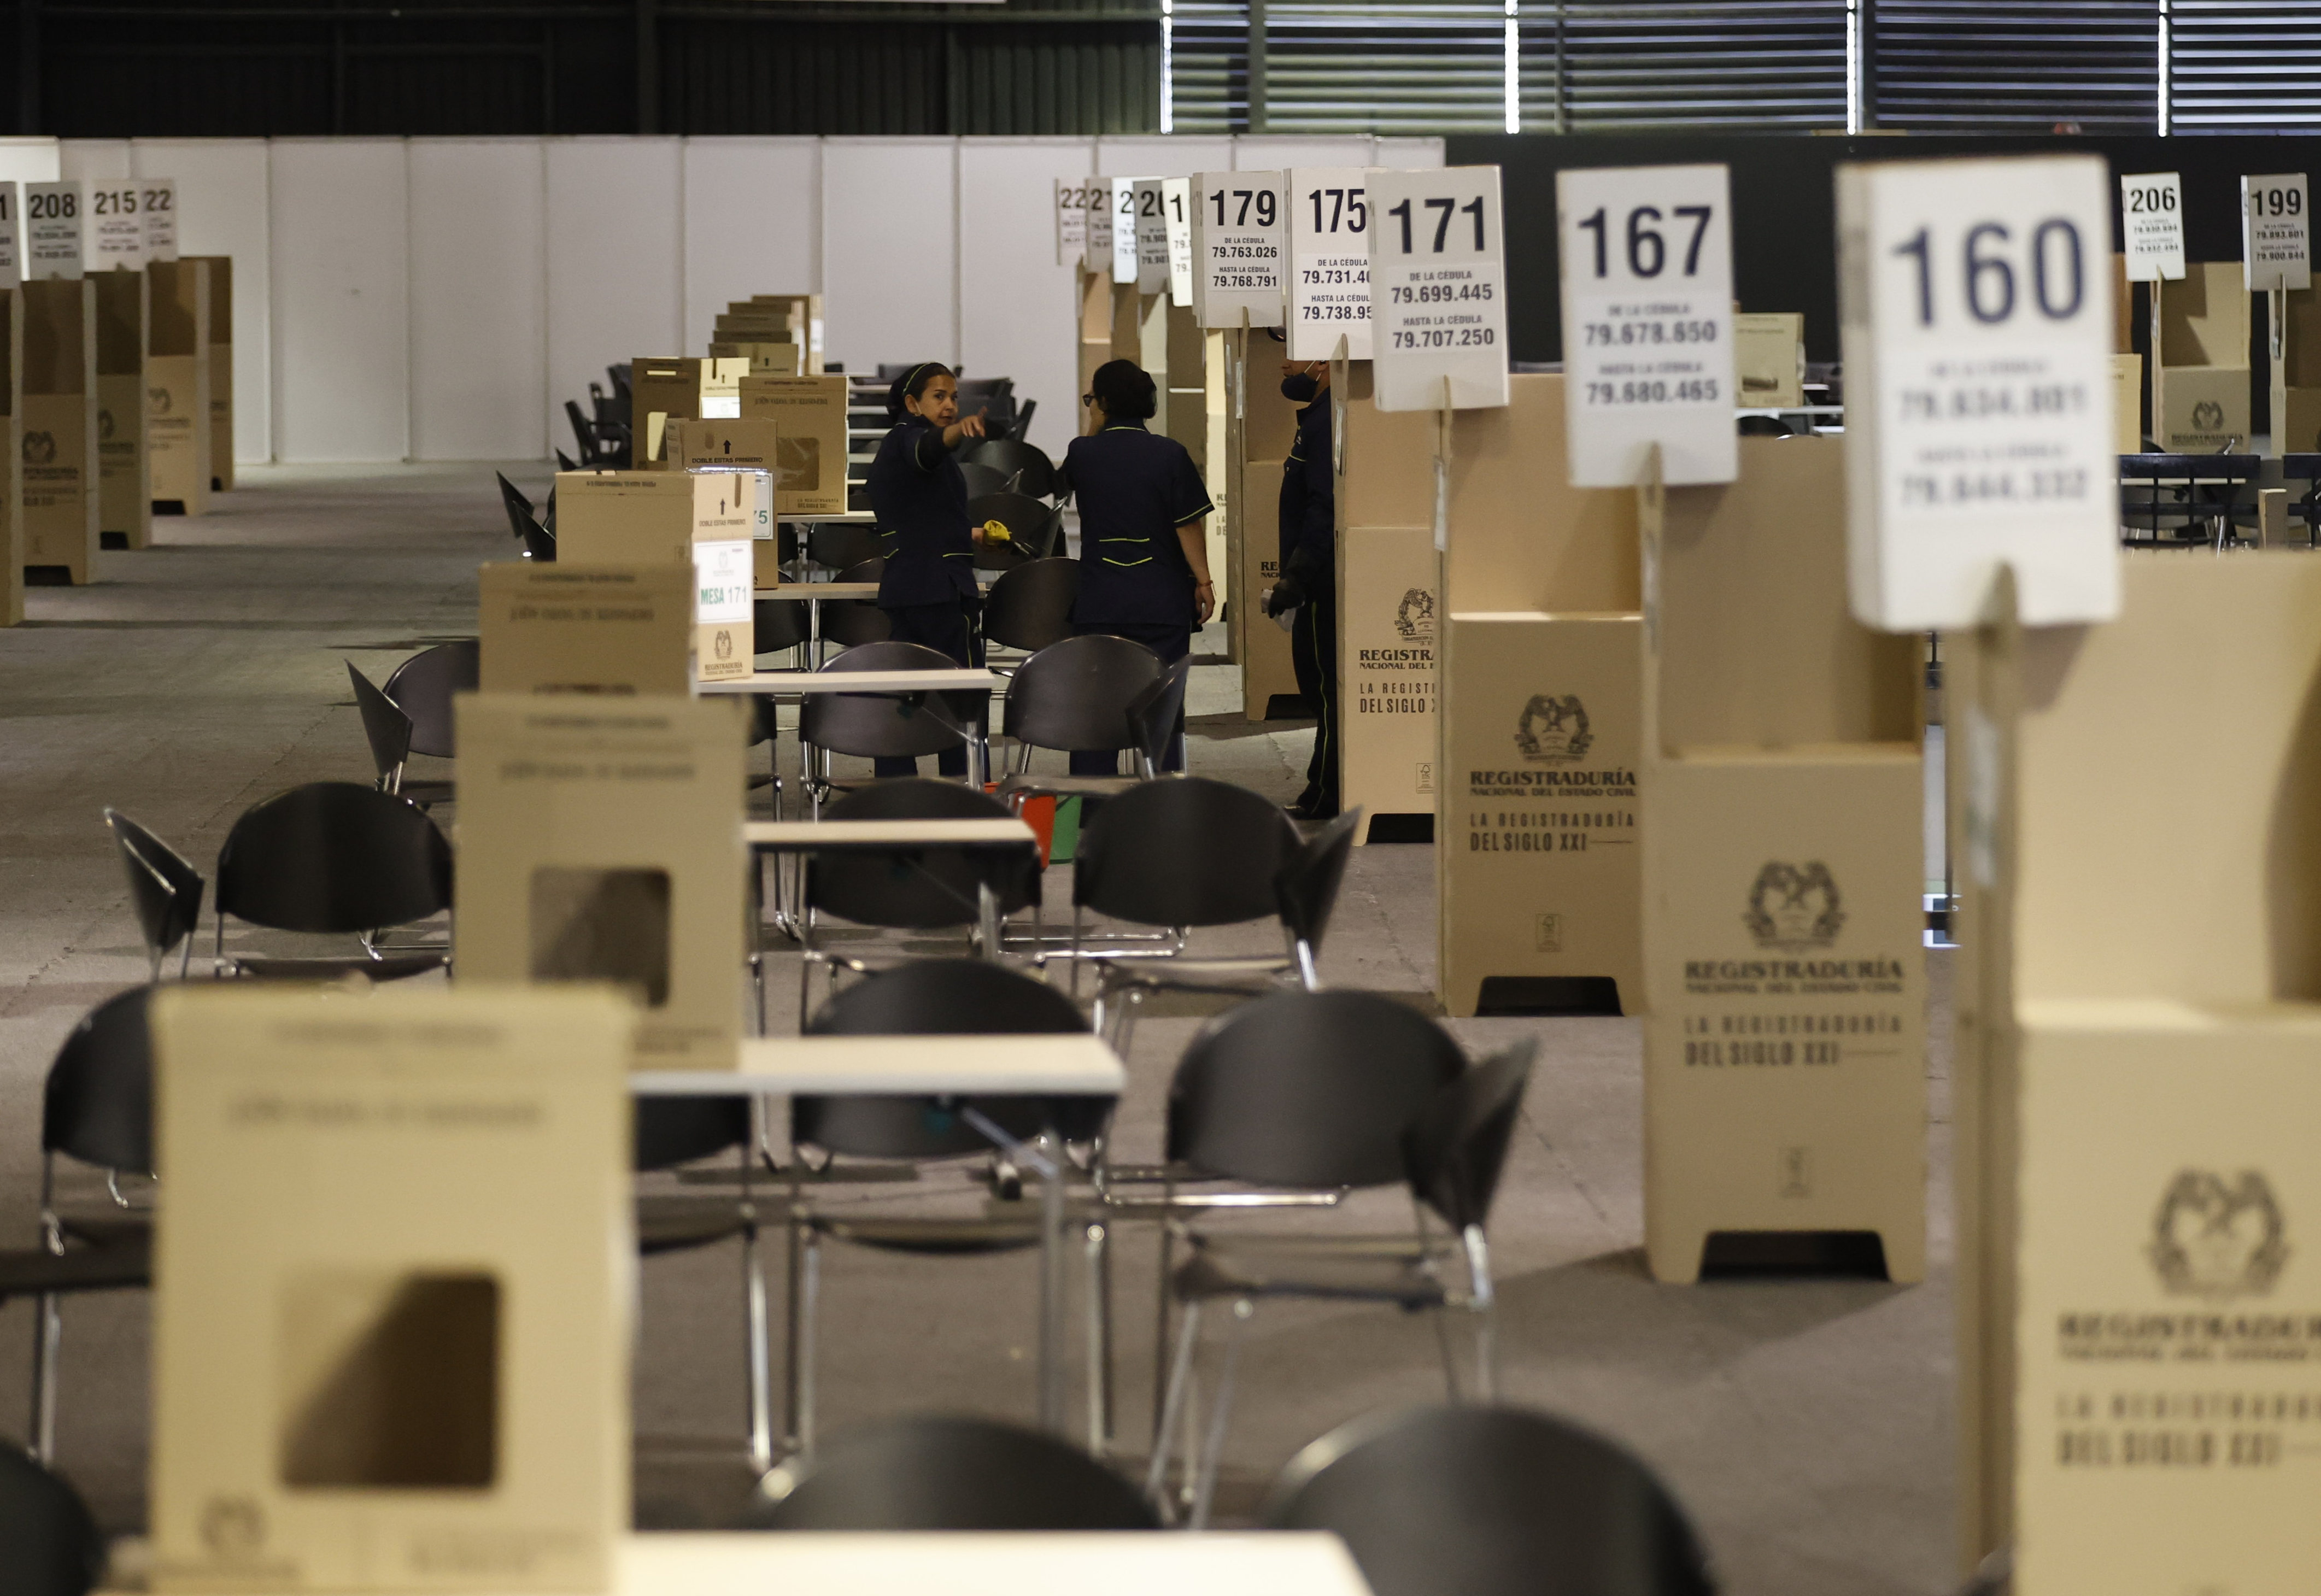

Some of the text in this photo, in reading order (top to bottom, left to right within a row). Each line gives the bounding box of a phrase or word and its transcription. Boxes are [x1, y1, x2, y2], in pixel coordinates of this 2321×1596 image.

[30, 192, 75, 219] 208
[94, 190, 136, 215] 215
[144, 189, 171, 212] 22
[1060, 188, 1086, 208] 22
[2130, 187, 2176, 213] 206
[2251, 189, 2301, 216] 199
[1210, 190, 1276, 227] 179
[1309, 189, 1366, 233] 175
[1388, 196, 1485, 254] 171
[1212, 247, 1277, 257] 79.763.026
[1578, 206, 1712, 279] 167
[1340, 257, 1368, 266] CÉDULA
[1213, 275, 1276, 286] 79.768.791
[1303, 271, 1369, 284] 79.731.4
[1410, 272, 1421, 281] DE
[1424, 272, 1434, 280] LA
[1891, 218, 2084, 326] 160
[1347, 294, 1370, 302] CÉDUL
[1391, 284, 1492, 303] 79.699.445
[1303, 306, 1372, 319] 79.738.95
[1403, 317, 1431, 326] HASTA
[1434, 316, 1445, 325] LA
[1393, 328, 1494, 348] 79.707.250
[1216, 526, 1227, 536] DE
[701, 585, 747, 606] MESA 171
[1359, 649, 1433, 660] REGISTR
[1360, 683, 1434, 694] LA REGIST
[1360, 698, 1425, 713] DEL SIGLO
[1470, 767, 1636, 785] REGISTRADURÍA
[1470, 832, 1586, 851] DEL SIGLO XXI
